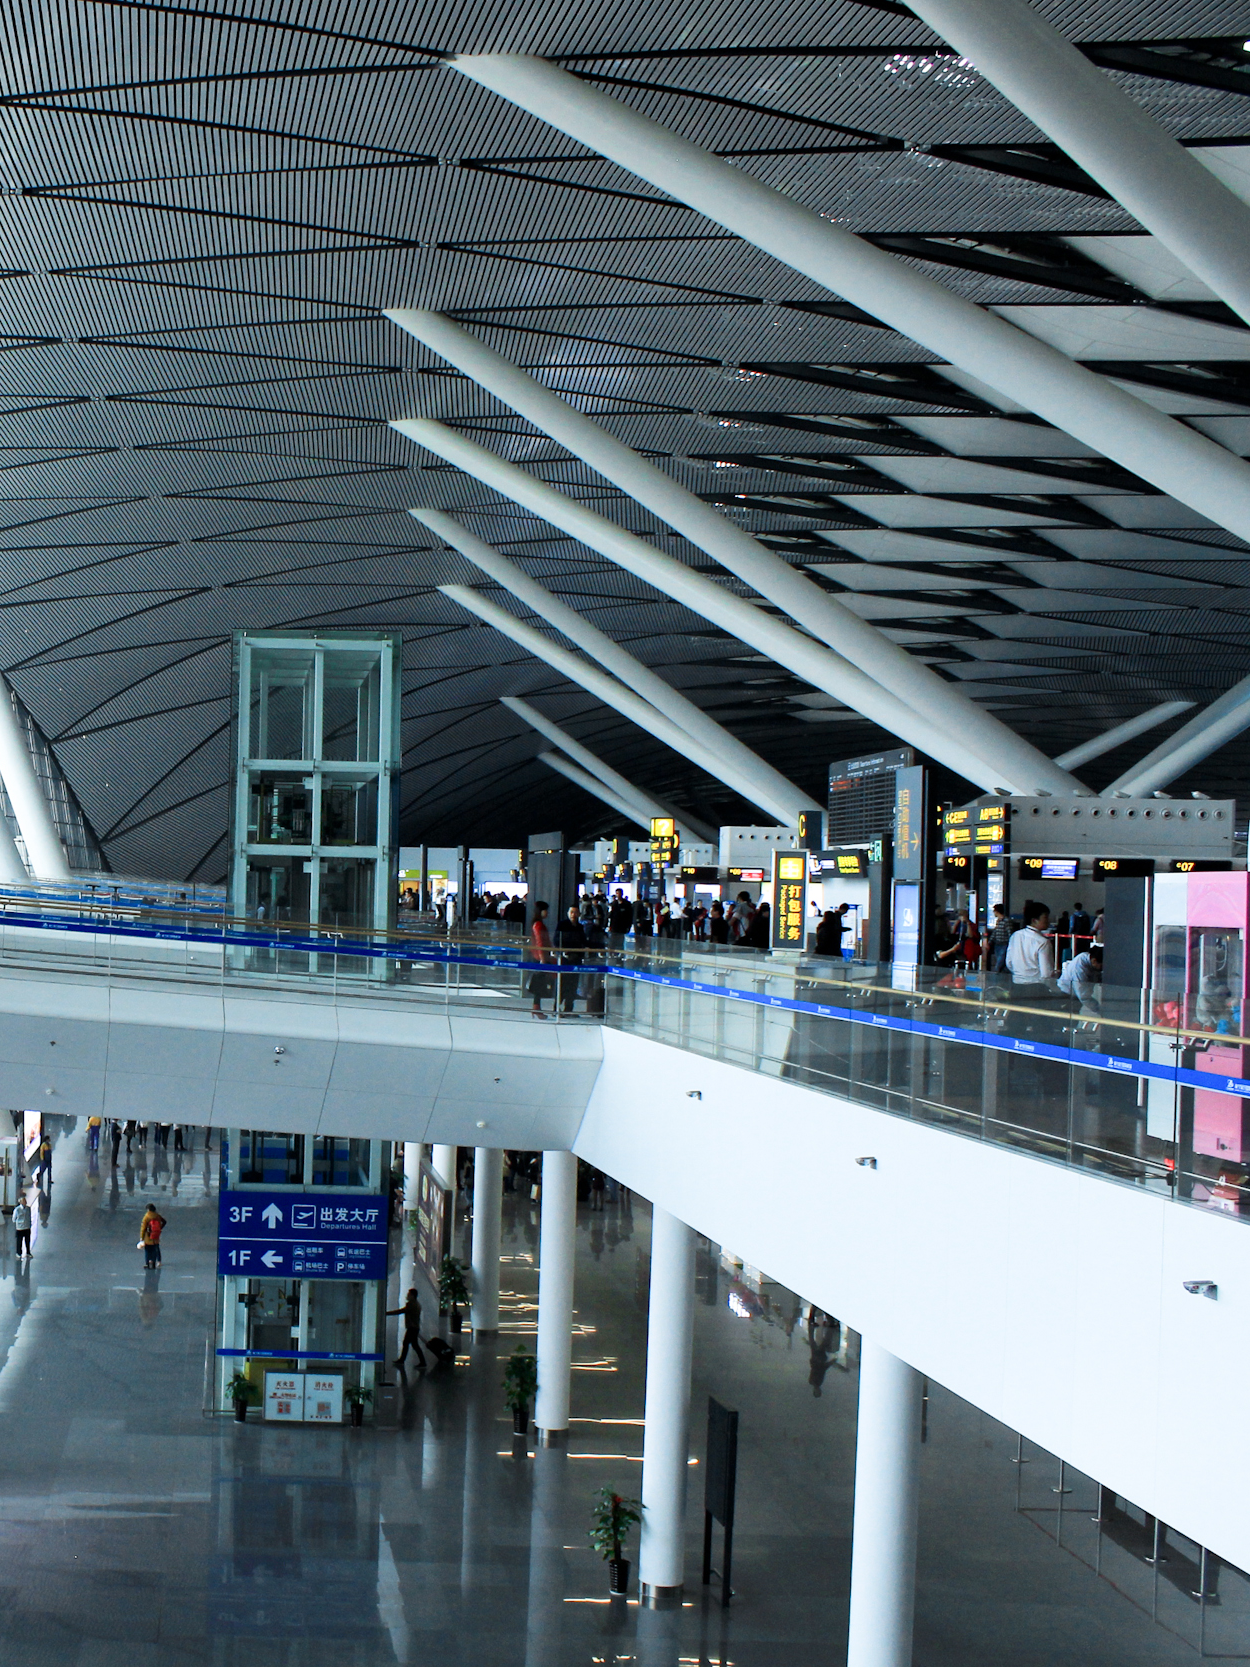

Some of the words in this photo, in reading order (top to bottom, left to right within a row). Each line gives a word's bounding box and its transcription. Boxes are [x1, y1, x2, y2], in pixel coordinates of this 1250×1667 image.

[799, 814, 807, 837] C
[787, 884, 802, 940] 打包服务
[228, 1206, 254, 1223] 3F
[320, 1206, 379, 1223] 出发大厅
[320, 1222, 360, 1231] Departures
[362, 1223, 377, 1231] Hall
[228, 1249, 252, 1267] 1F
